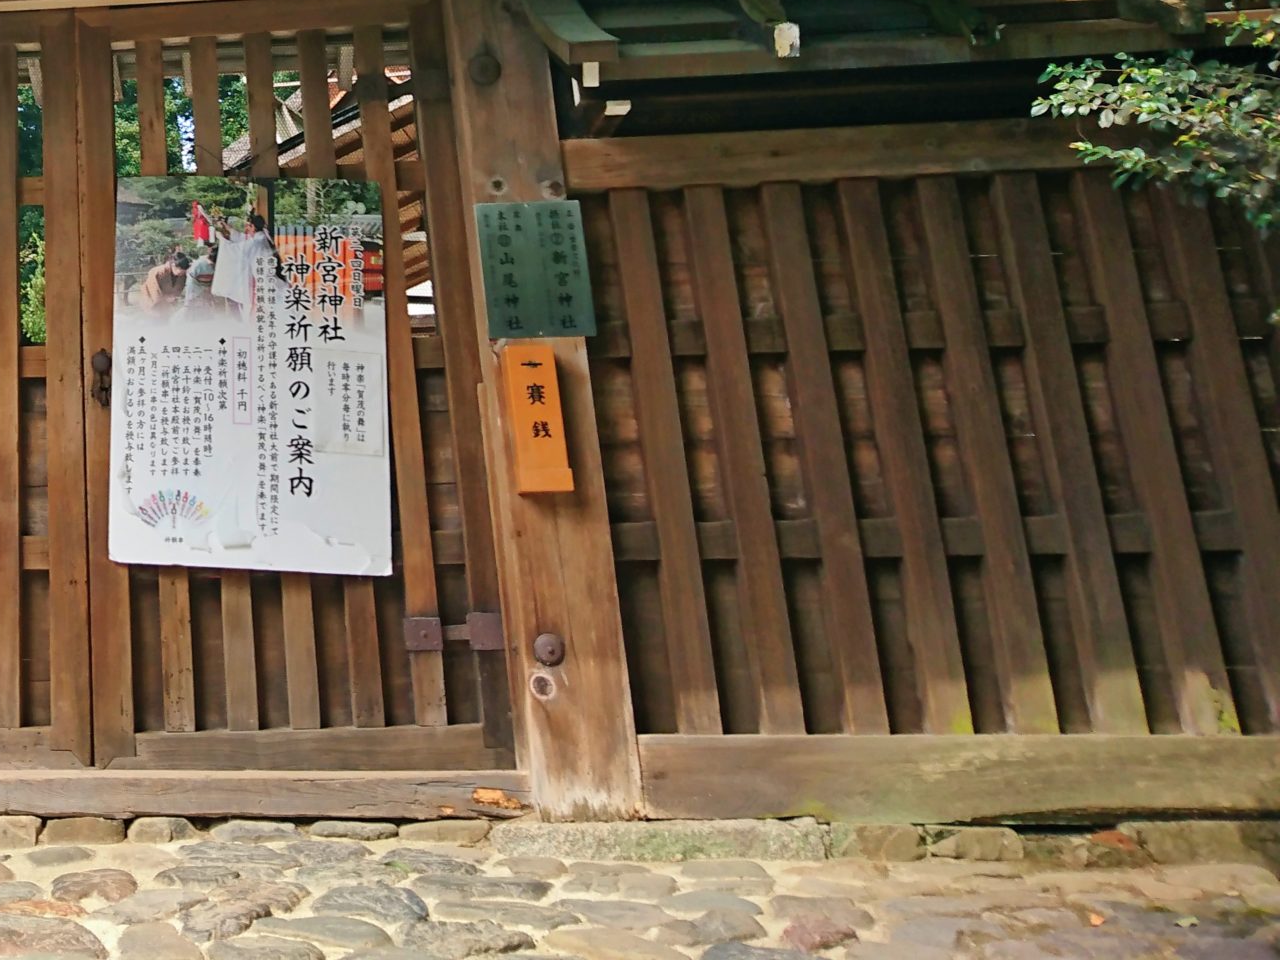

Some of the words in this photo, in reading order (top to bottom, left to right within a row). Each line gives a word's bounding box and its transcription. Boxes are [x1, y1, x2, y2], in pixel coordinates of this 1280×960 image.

[315, 227, 346, 343] 新宮神社
[499, 251, 524, 331] 山尾神社
[551, 250, 577, 330] 新宮神社
[236, 348, 248, 382] 初穂料
[236, 389, 248, 412] 千円
[282, 255, 315, 498] 神楽祈願のご案内
[327, 360, 337, 396] 行います
